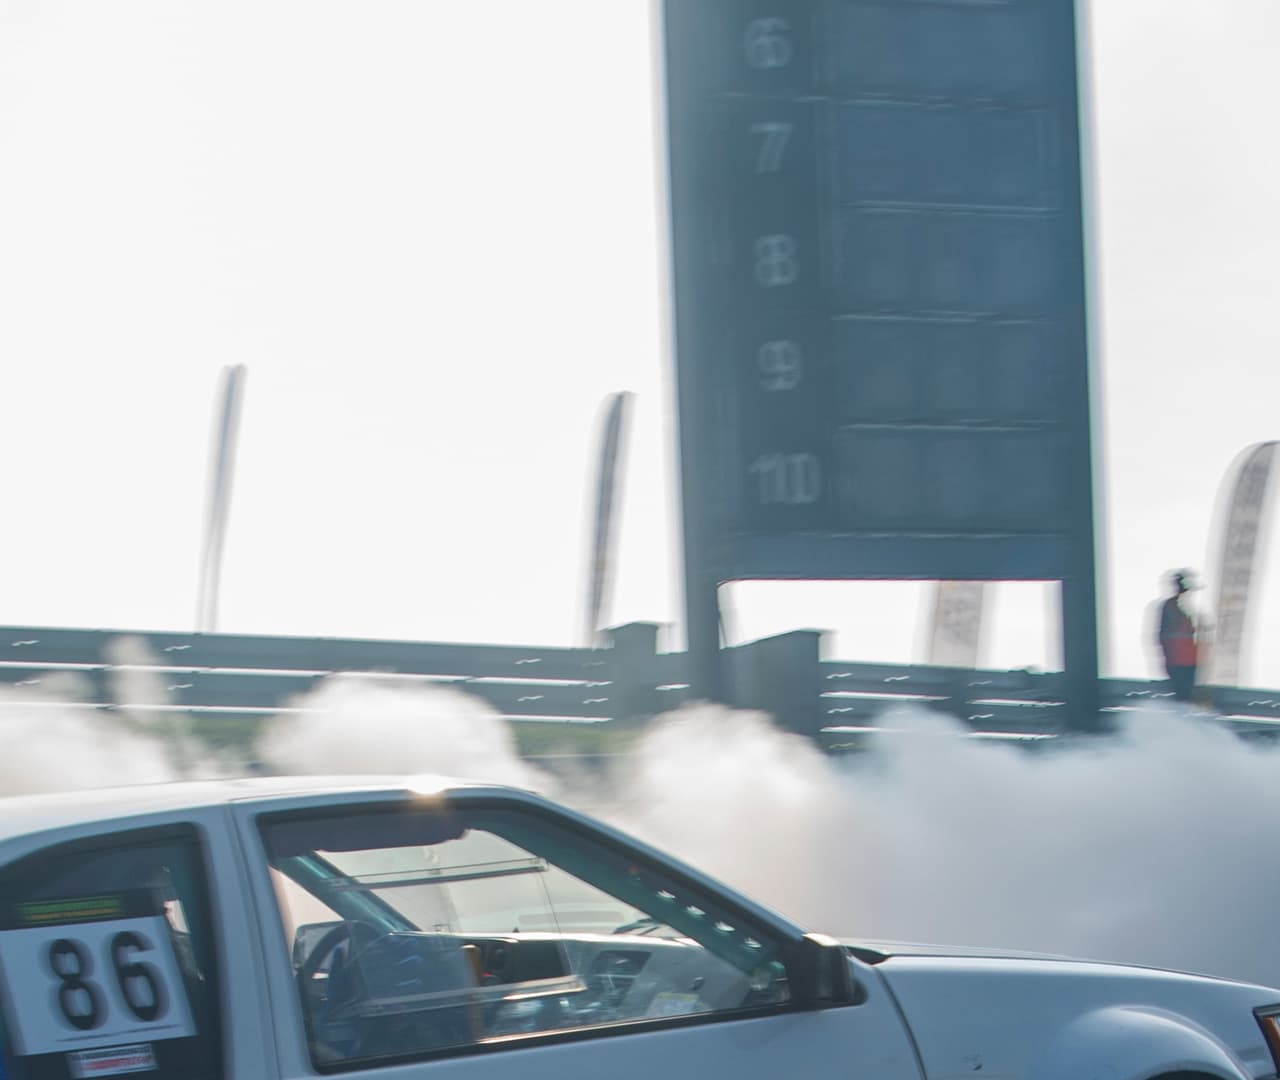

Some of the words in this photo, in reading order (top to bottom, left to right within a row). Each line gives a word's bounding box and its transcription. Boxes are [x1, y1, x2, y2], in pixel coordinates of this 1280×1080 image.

[744, 17, 793, 69] 6
[747, 122, 794, 174] 7
[753, 233, 799, 287] 8
[757, 339, 802, 391] 9
[748, 452, 820, 505] 10
[42, 931, 170, 1031] 86
